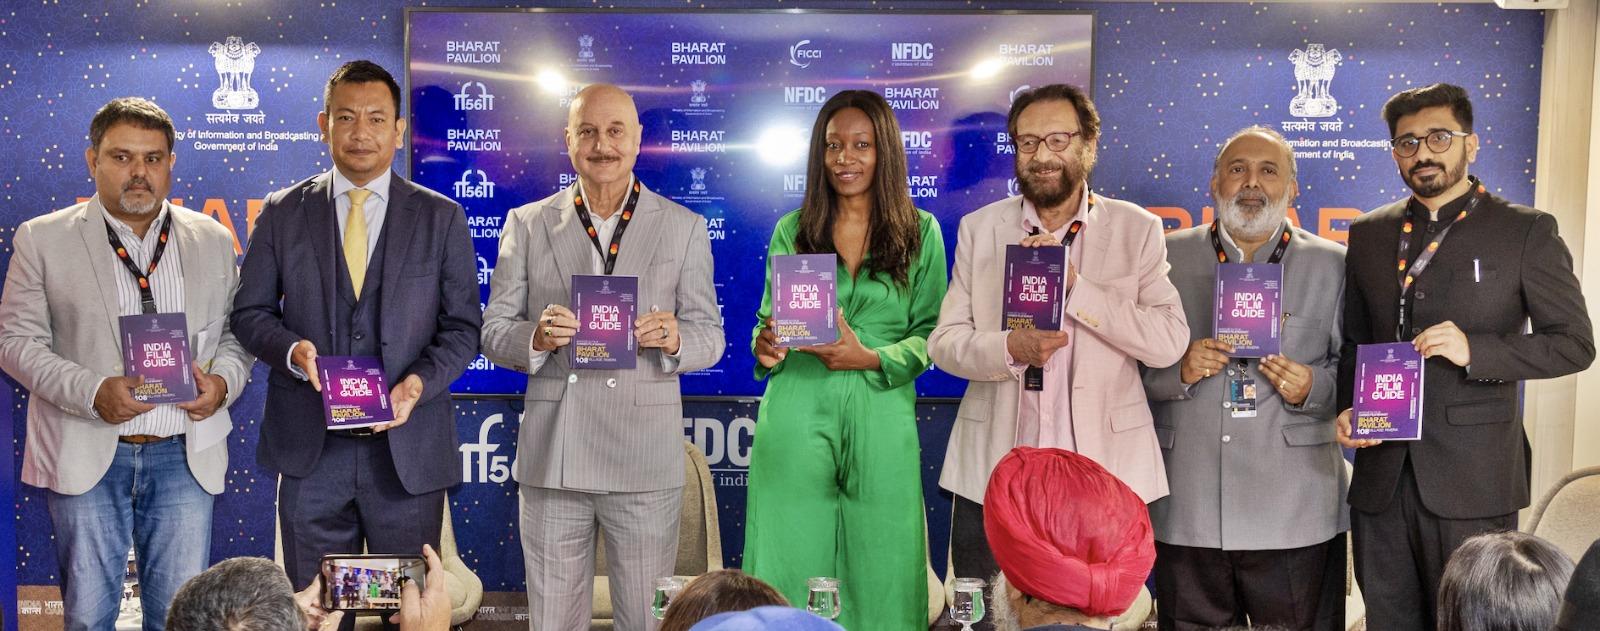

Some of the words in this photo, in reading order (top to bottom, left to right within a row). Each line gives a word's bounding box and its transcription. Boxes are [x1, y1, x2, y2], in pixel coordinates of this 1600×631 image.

[446, 41, 500, 52] BHARAT
[672, 42, 726, 52] BHARAT
[892, 43, 933, 60] NFDC
[1000, 44, 1054, 54] BHARAT
[446, 53, 500, 63] PAVILION
[672, 54, 726, 64] PAVILION
[797, 50, 821, 58] FICCI
[1000, 56, 1054, 66] PAVILION
[784, 87, 826, 103] NFDC
[885, 88, 939, 98] BHARAT
[206, 110, 239, 124] सत्यमेव
[243, 110, 266, 124] जयते
[1281, 118, 1315, 132] सत्यमेव
[1320, 118, 1344, 132] जयते
[187, 130, 196, 139] of
[198, 130, 244, 139] Information
[247, 131, 262, 139] and
[264, 132, 319, 141] Broadcasting
[448, 129, 500, 140] BHARAT
[672, 130, 725, 140] BHARAT
[902, 131, 931, 147] FDC
[194, 142, 246, 150] Government
[248, 142, 256, 150] of
[258, 142, 278, 150] India
[448, 142, 500, 151] PAVILION
[672, 143, 725, 152] PAVILION
[1285, 139, 1320, 147] rmation
[1322, 139, 1338, 147] and
[1341, 139, 1391, 148] Broadcastin
[1294, 150, 1320, 159] nment
[1333, 150, 1354, 159] India
[784, 175, 806, 190] NF
[906, 176, 937, 186] RAT
[909, 188, 937, 198] LION
[468, 216, 501, 226] ARAT
[471, 228, 500, 238] ILION
[1022, 276, 1047, 285] INDIA
[1023, 285, 1046, 293] FILM
[1019, 293, 1048, 302] GUIDE
[1235, 293, 1263, 301] INDIA
[592, 305, 619, 314] INDIA
[1236, 301, 1261, 309] FILM
[1232, 310, 1265, 318] GUIDE
[589, 322, 621, 330] GUIDE
[143, 342, 172, 351] INDIA
[146, 351, 171, 359] FILM
[143, 358, 176, 367] GUIDE
[1375, 374, 1403, 383] INDIA
[1376, 382, 1402, 391] FILM
[1372, 390, 1404, 399] GUIDE
[683, 418, 757, 466] DC
[720, 474, 749, 486] indi
